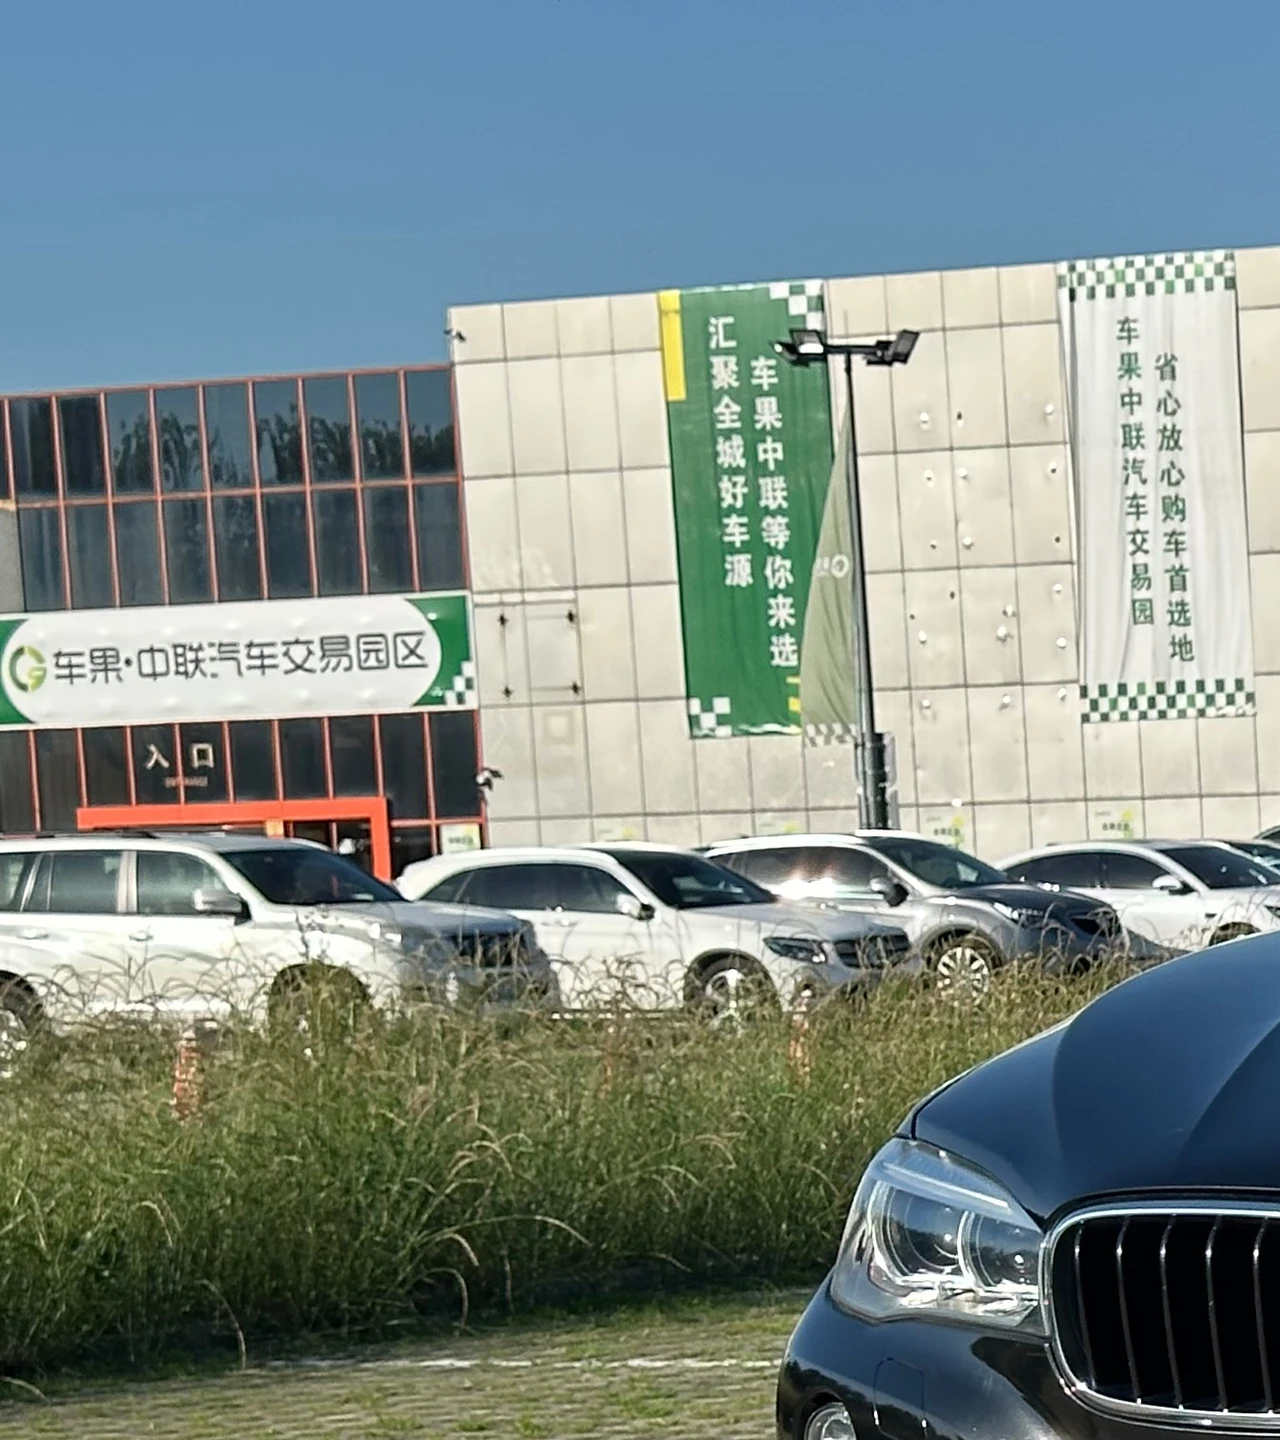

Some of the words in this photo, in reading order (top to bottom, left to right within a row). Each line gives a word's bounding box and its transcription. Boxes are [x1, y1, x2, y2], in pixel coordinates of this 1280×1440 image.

[708, 315, 754, 588] 汇聚全城好车源
[750, 355, 799, 668] 车果中联等你来选
[1116, 316, 1154, 625] 车果中联汽车交易园
[1155, 352, 1195, 662] 省心放心购车首选地
[54, 631, 429, 685] 车果·中联汽车交易园区
[145, 743, 215, 770] 入口
